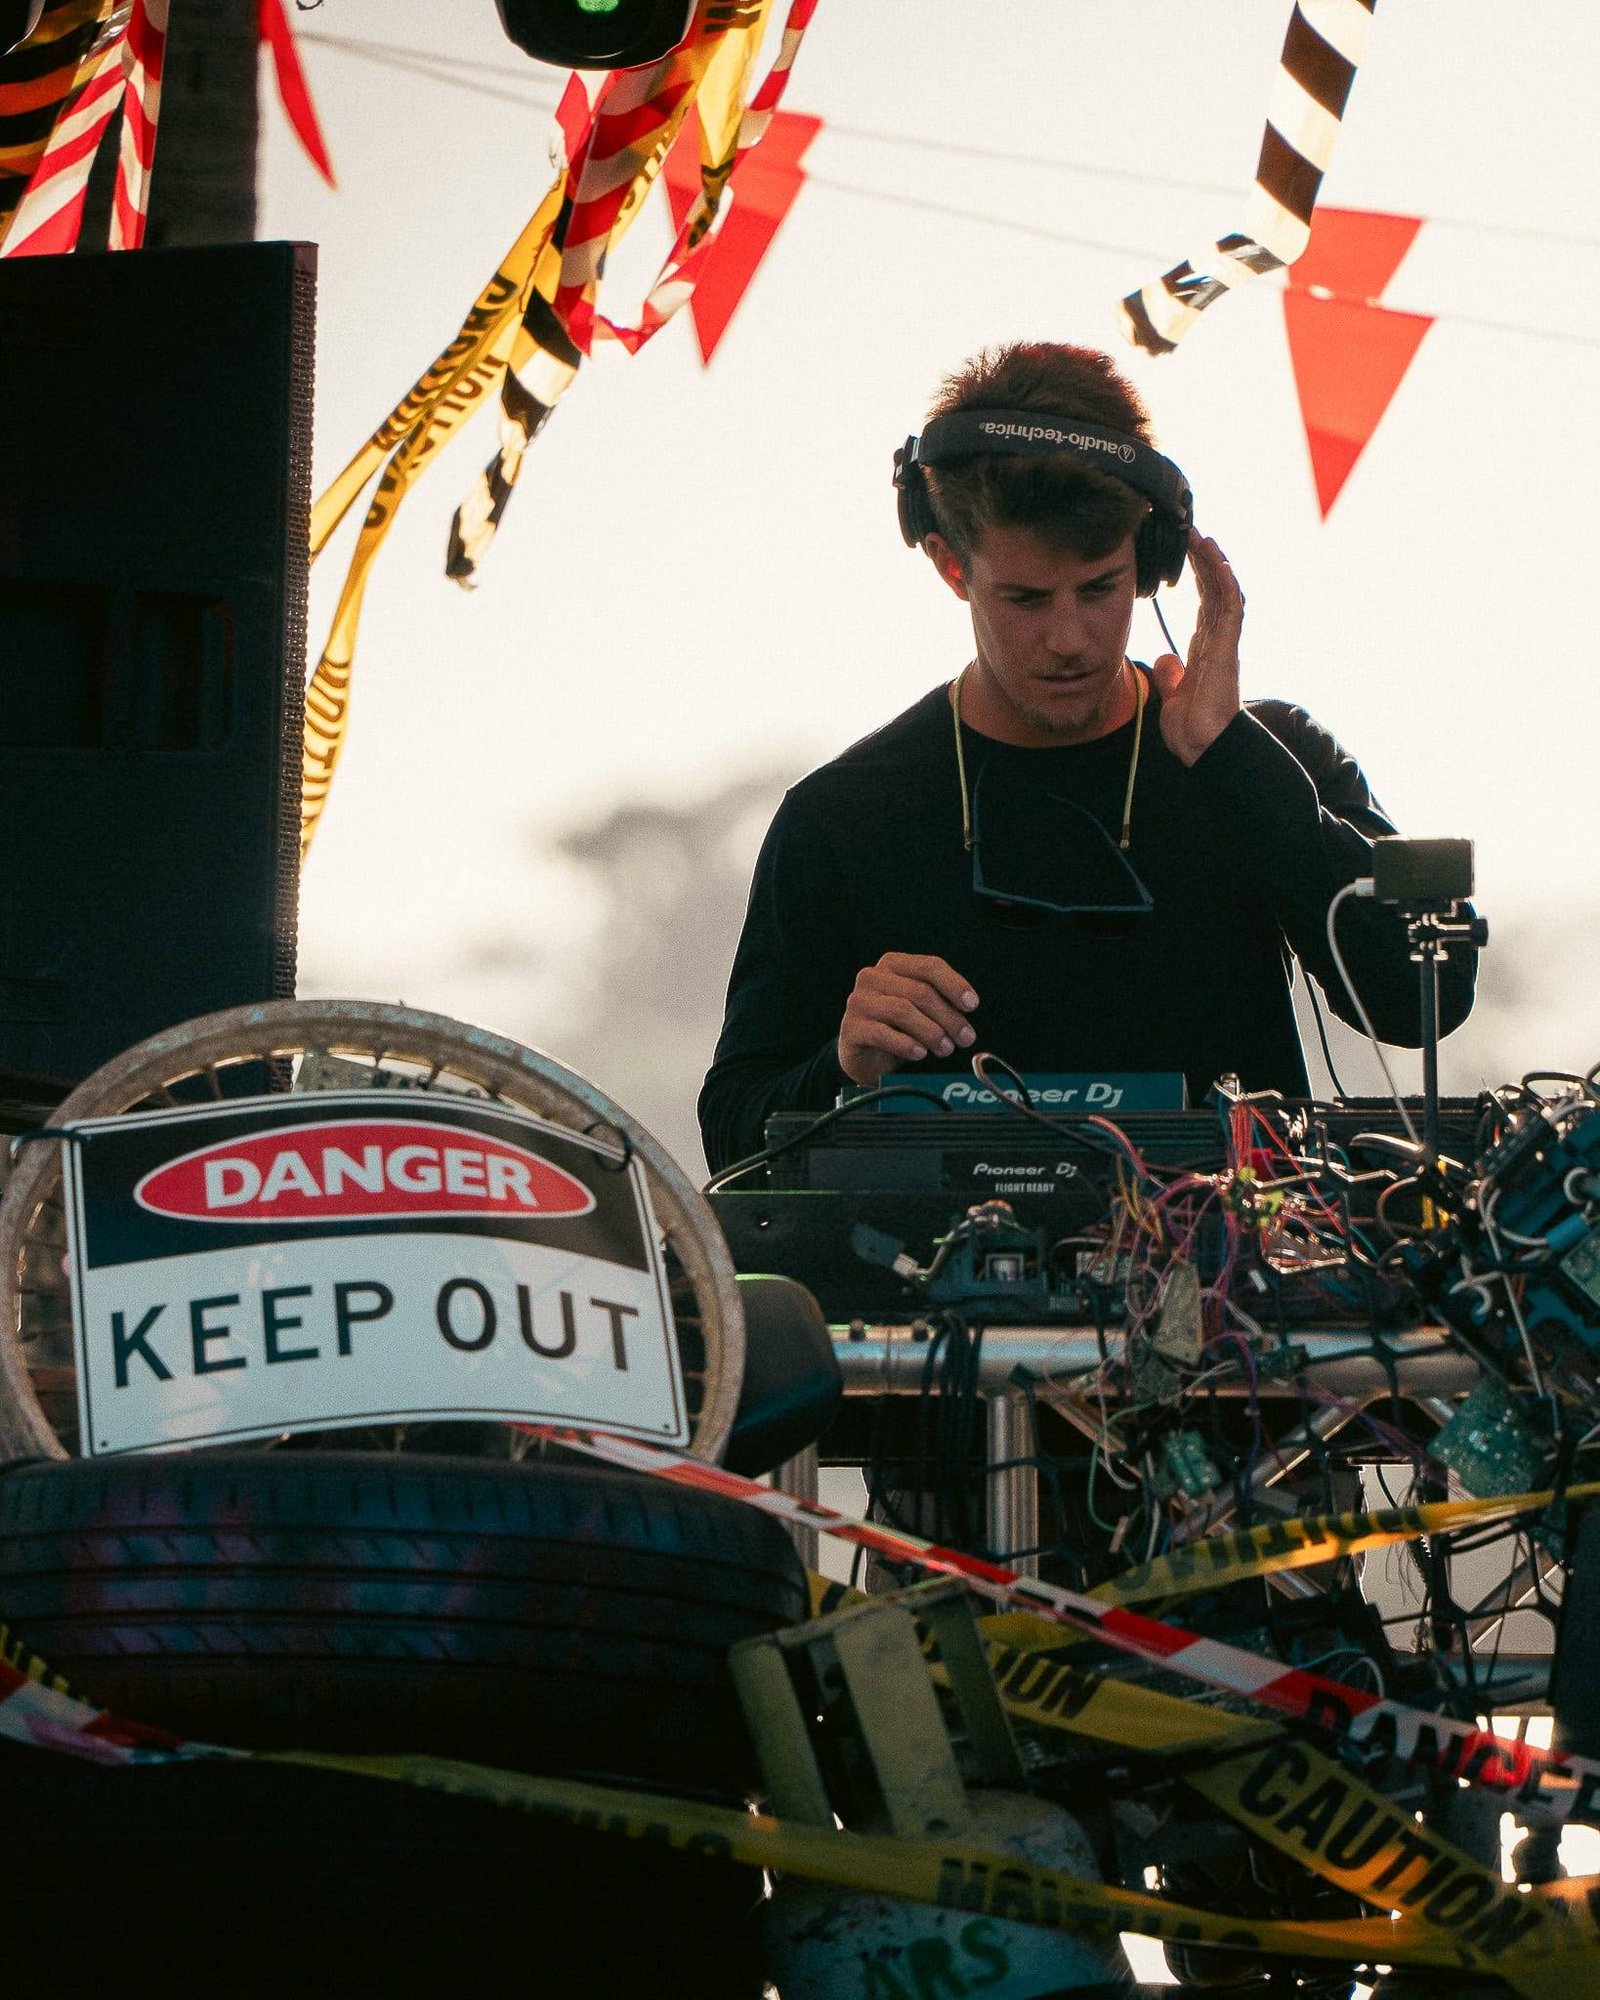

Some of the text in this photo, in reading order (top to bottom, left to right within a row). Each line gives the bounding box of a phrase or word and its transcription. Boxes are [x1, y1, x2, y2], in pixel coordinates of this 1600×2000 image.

[984, 421, 1118, 455] audio-technica
[204, 1145, 537, 1208] DANGER
[973, 1162, 1046, 1176] Pioneer
[111, 1277, 639, 1389] KEEP OUT
[1239, 1746, 1543, 1957] CAUTION
